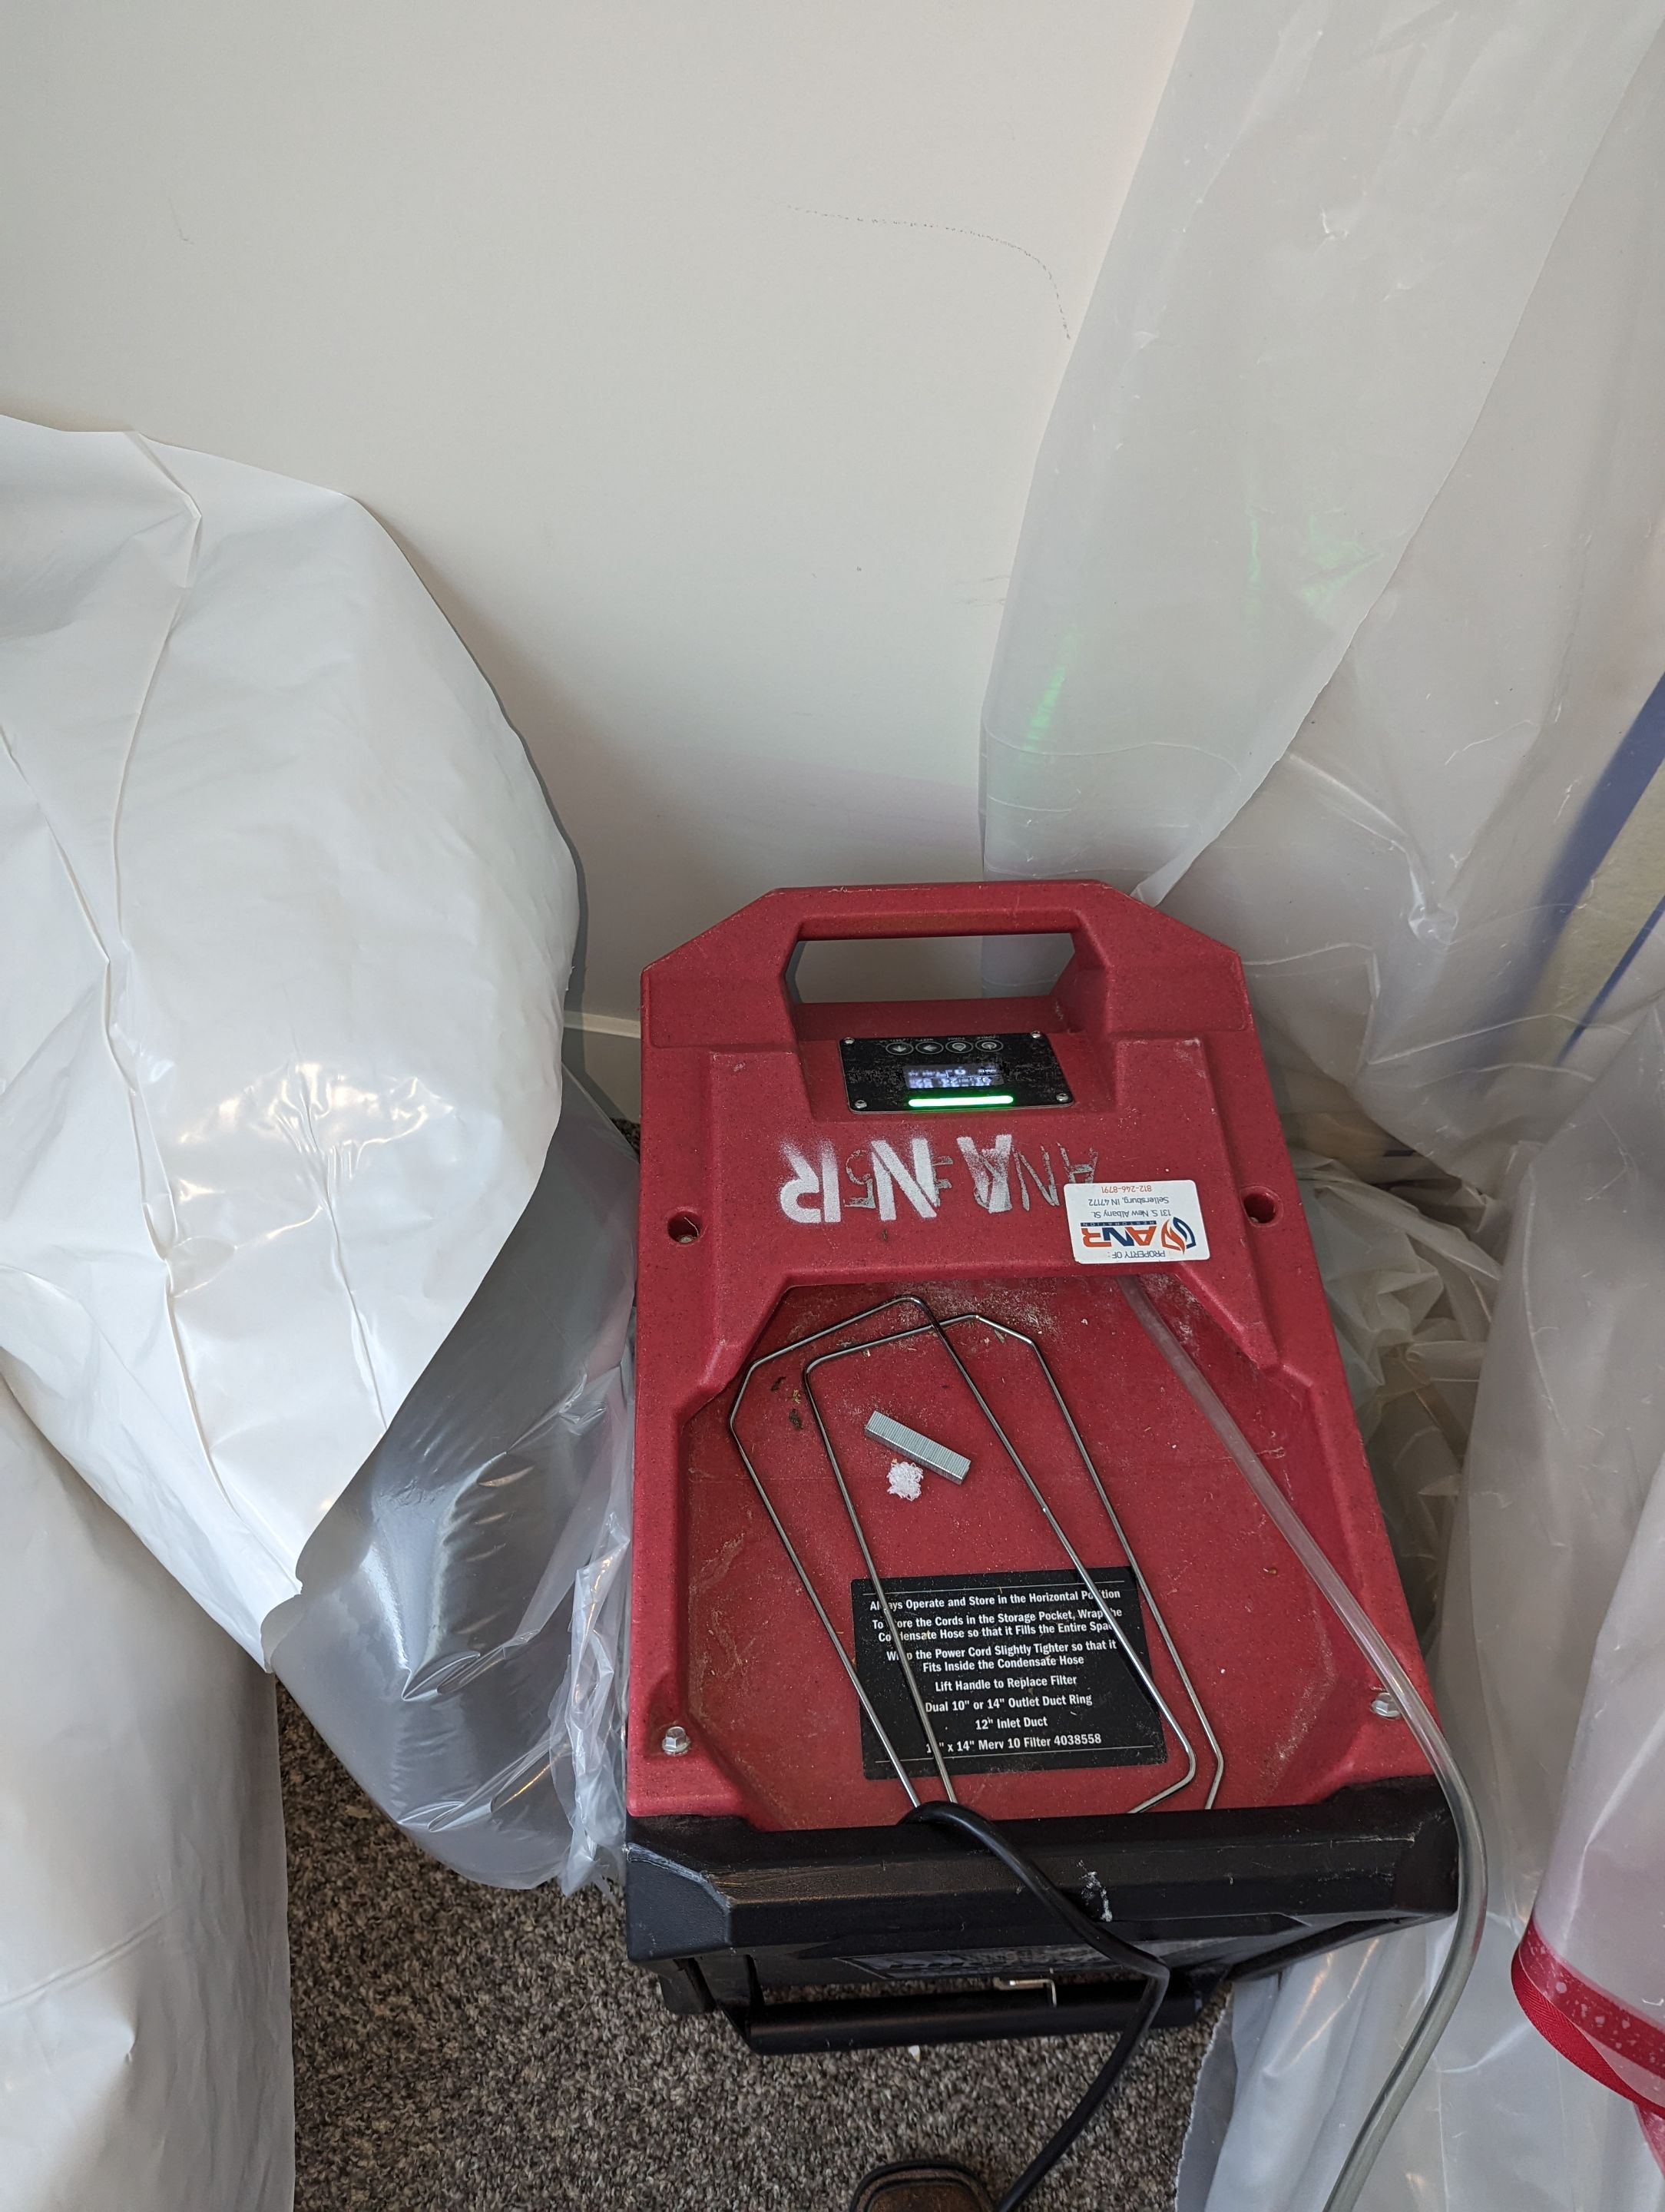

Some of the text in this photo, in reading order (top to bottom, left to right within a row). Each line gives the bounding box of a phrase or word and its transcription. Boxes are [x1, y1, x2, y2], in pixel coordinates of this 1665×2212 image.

[1104, 1209, 1129, 1217] Albany
[1081, 1227, 1157, 1247] ANR
[870, 1589, 1120, 1611] Alays Operate and Store in the Horizontal Potion
[872, 1620, 883, 1629] To
[915, 1618, 932, 1627] the
[935, 1616, 963, 1626] Cords
[966, 1615, 975, 1624] in
[978, 1614, 995, 1624] the
[998, 1614, 1035, 1623] Storage
[1039, 1611, 1075, 1621] Pocket,
[1077, 1608, 1104, 1619] Wrap
[940, 1629, 964, 1638] Hose
[981, 1627, 1002, 1636] that
[1005, 1626, 1013, 1635] it
[1015, 1625, 1036, 1634] Fills
[1038, 1624, 1054, 1634] the
[1058, 1623, 1087, 1632] Entire
[915, 1650, 932, 1659] the
[935, 1649, 965, 1658] Power
[968, 1646, 991, 1657] Cord
[995, 1644, 1031, 1657] Slightly
[1034, 1643, 1068, 1655] Tighter
[1086, 1641, 1107, 1650] that
[1109, 1640, 1117, 1649] it
[923, 1655, 1084, 1672] Fits Inside the Condensate Hose
[935, 1675, 1077, 1691] Lift Handle to Replace Filter
[925, 1702, 948, 1712] Dual
[952, 1700, 969, 1710] 10"
[988, 1698, 1004, 1709] 14"
[1008, 1697, 1040, 1707] Outlet
[1043, 1695, 1066, 1706] Duct
[1069, 1694, 1092, 1705] Ring
[975, 1717, 1048, 1730] 12" Inlet Duct
[926, 1743, 944, 1753] 1"
[957, 1740, 974, 1751] 14"
[978, 1740, 1004, 1750] Merv
[1008, 1738, 1020, 1748] 10
[1024, 1737, 1051, 1747] Filter
[1054, 1734, 1101, 1745] 4038558
